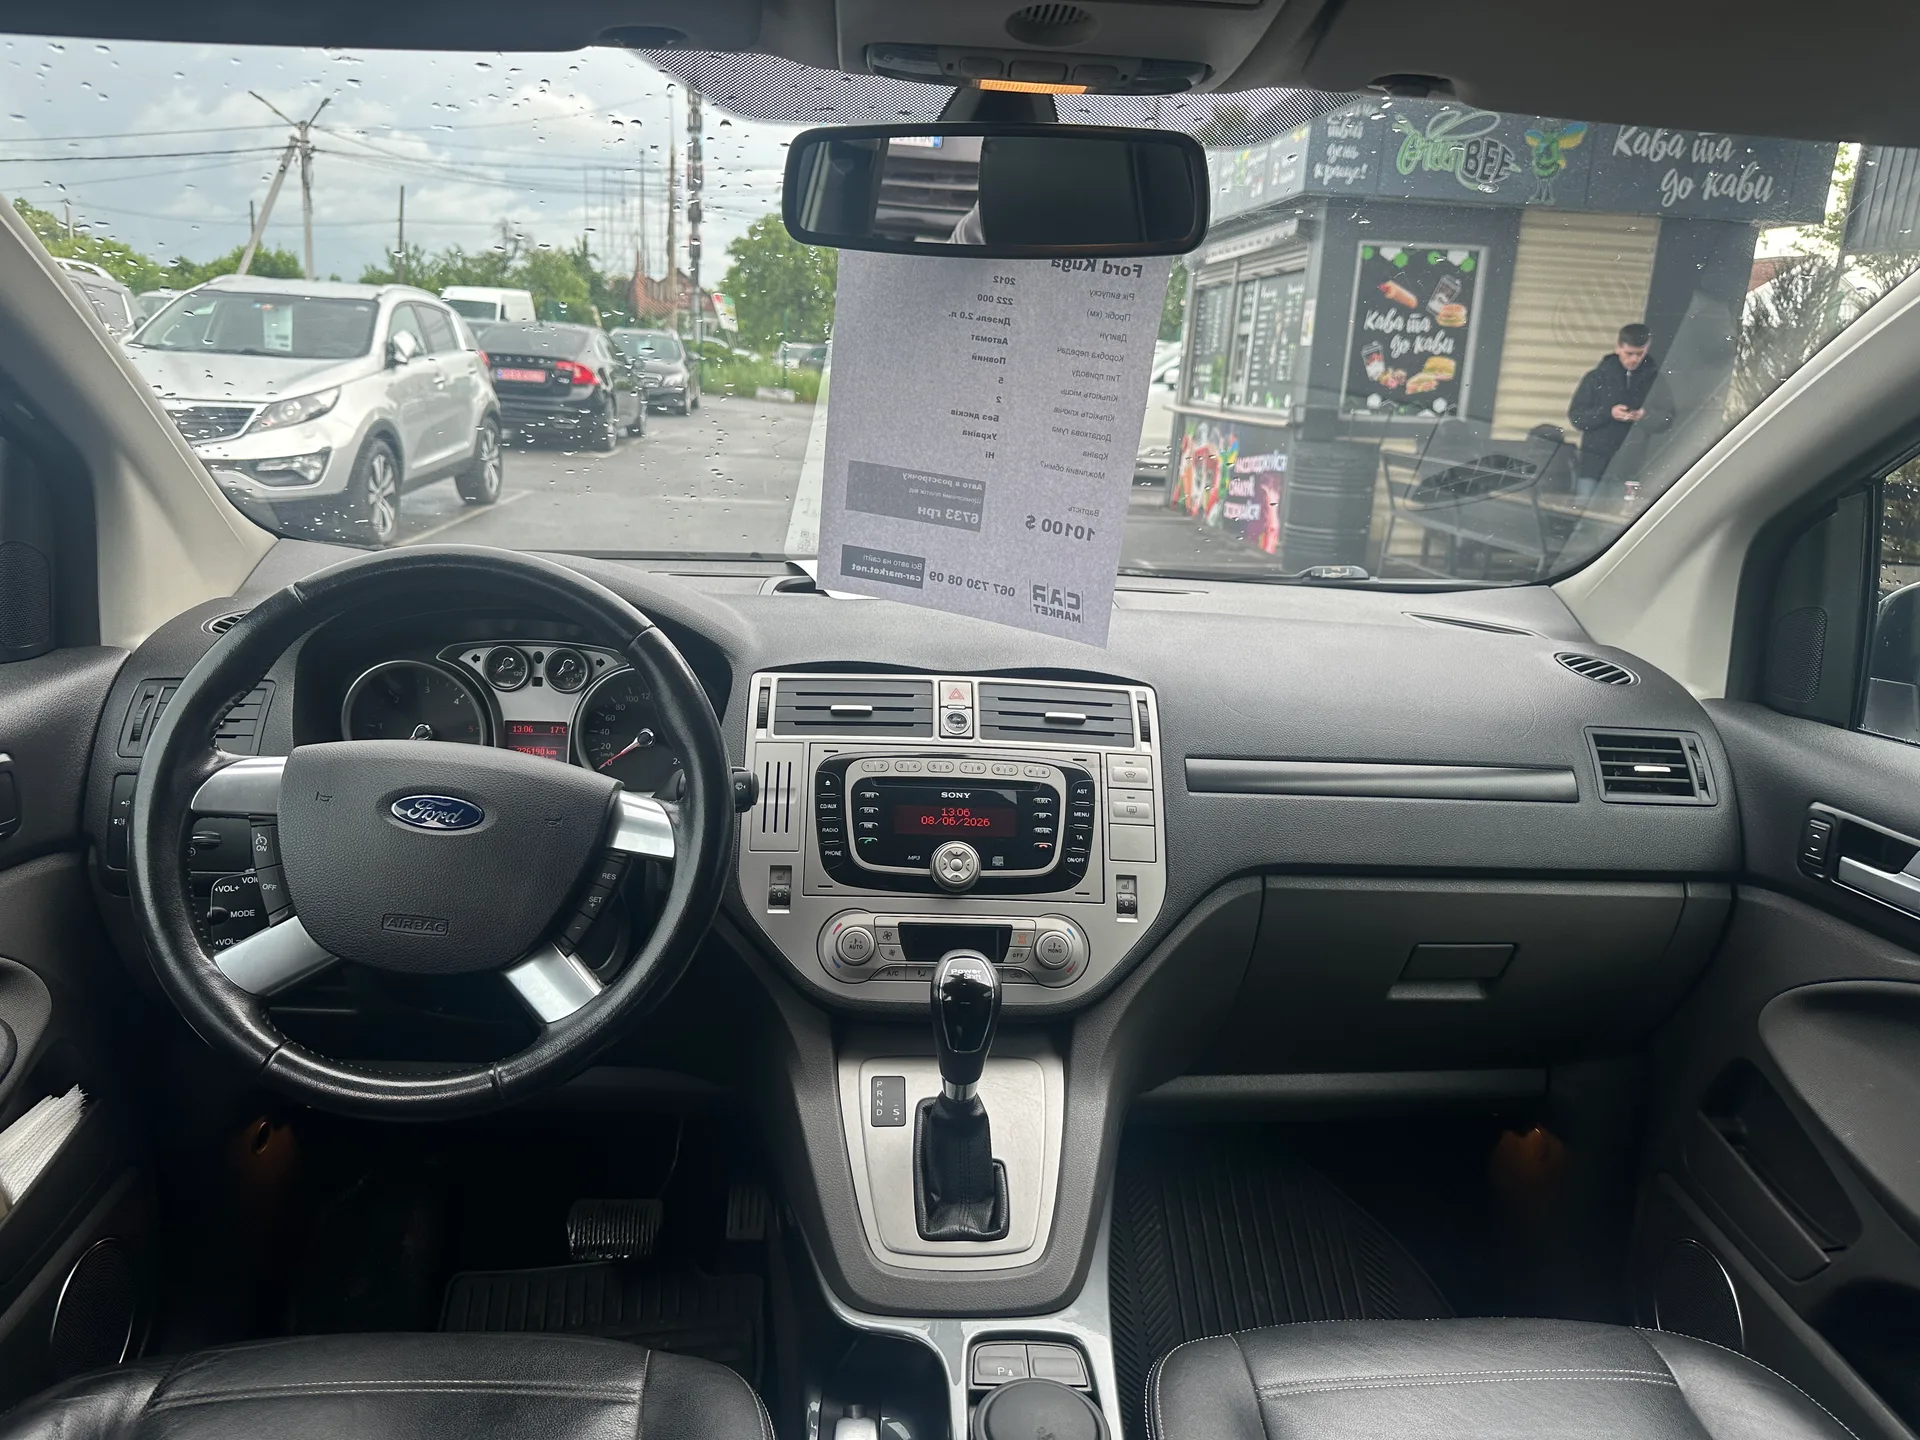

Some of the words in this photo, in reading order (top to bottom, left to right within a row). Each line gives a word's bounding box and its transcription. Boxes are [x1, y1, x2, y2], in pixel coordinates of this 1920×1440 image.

[1612, 124, 1687, 162] Кава
[1692, 132, 1736, 164] та
[1661, 168, 1694, 207] до
[1701, 161, 1774, 203] кави
[1364, 307, 1405, 333] Кава
[1406, 313, 1432, 333] та
[1390, 334, 1411, 358] до
[1413, 329, 1455, 355] кави
[940, 791, 971, 799] SONY
[407, 799, 465, 824] Ford
[921, 815, 991, 827] 08/06/2026
[602, 872, 617, 880] RES
[218, 885, 240, 893] VOL+
[230, 909, 255, 918] MODE
[386, 917, 446, 933] AIRBAG
[997, 1367, 1005, 1376] P
